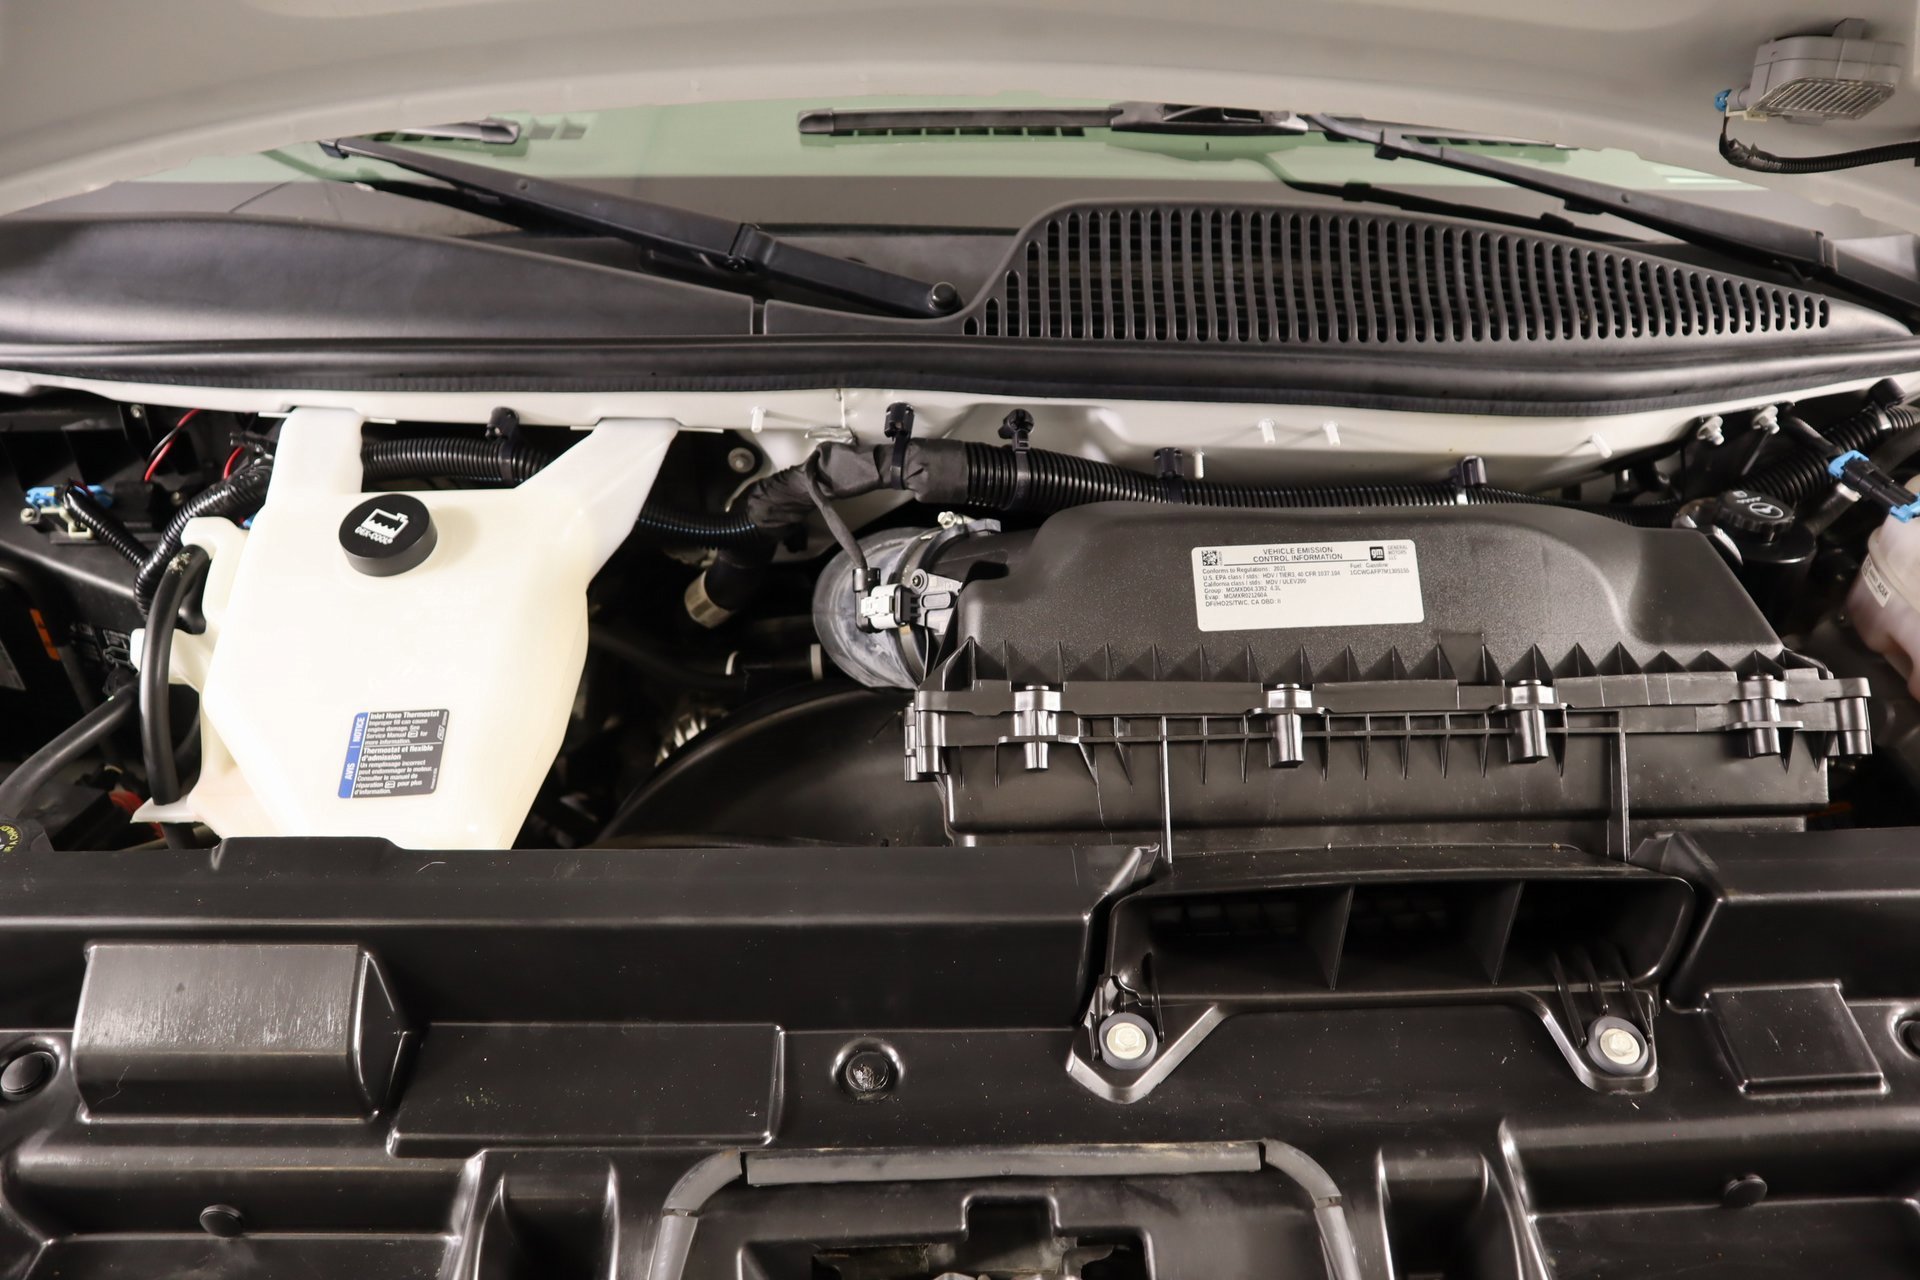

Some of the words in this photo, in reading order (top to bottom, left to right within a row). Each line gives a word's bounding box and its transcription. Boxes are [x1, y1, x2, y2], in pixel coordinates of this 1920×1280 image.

[1292, 554, 1343, 562] INFORMATION
[352, 717, 365, 742] NOTICE
[345, 763, 355, 780] AVIS
